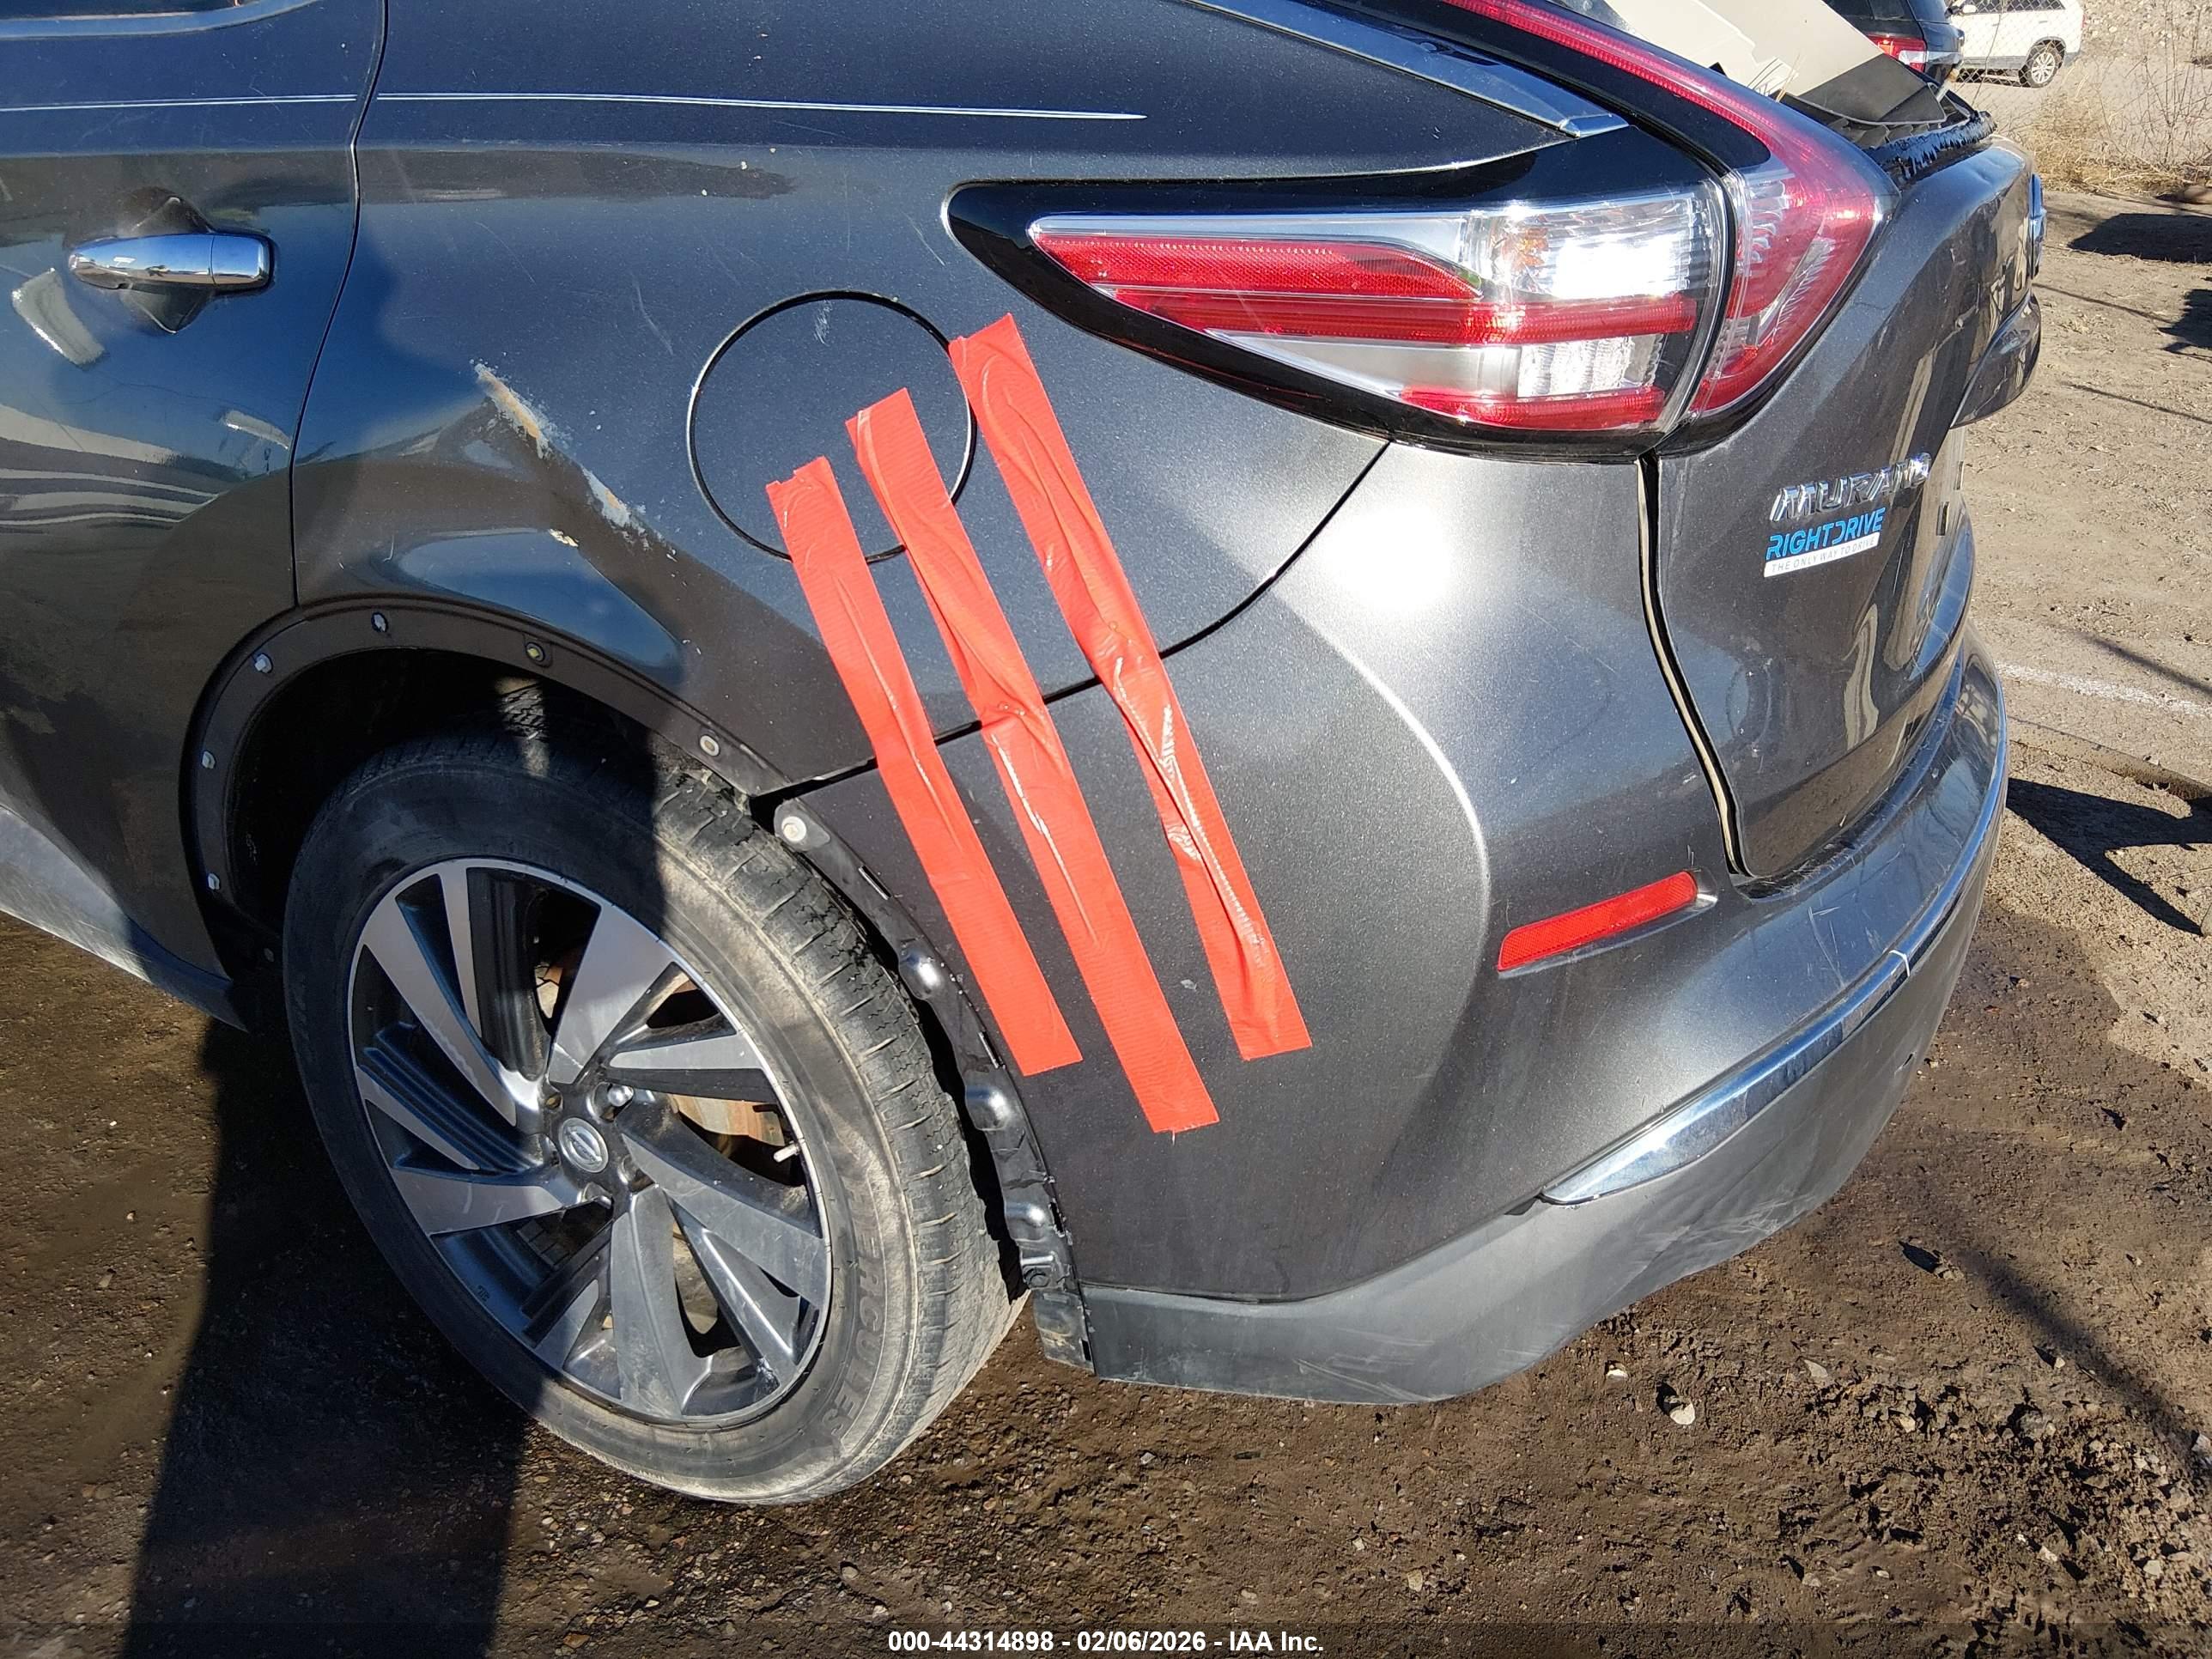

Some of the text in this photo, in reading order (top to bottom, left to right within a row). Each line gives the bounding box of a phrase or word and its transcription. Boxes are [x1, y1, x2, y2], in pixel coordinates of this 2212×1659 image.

[1765, 507, 1886, 561] RIGHTDRIVE
[1771, 561, 1790, 573] THE
[1793, 554, 1818, 568] ONLY
[1820, 549, 1838, 562] WAY
[1852, 537, 1875, 553] DRIVE
